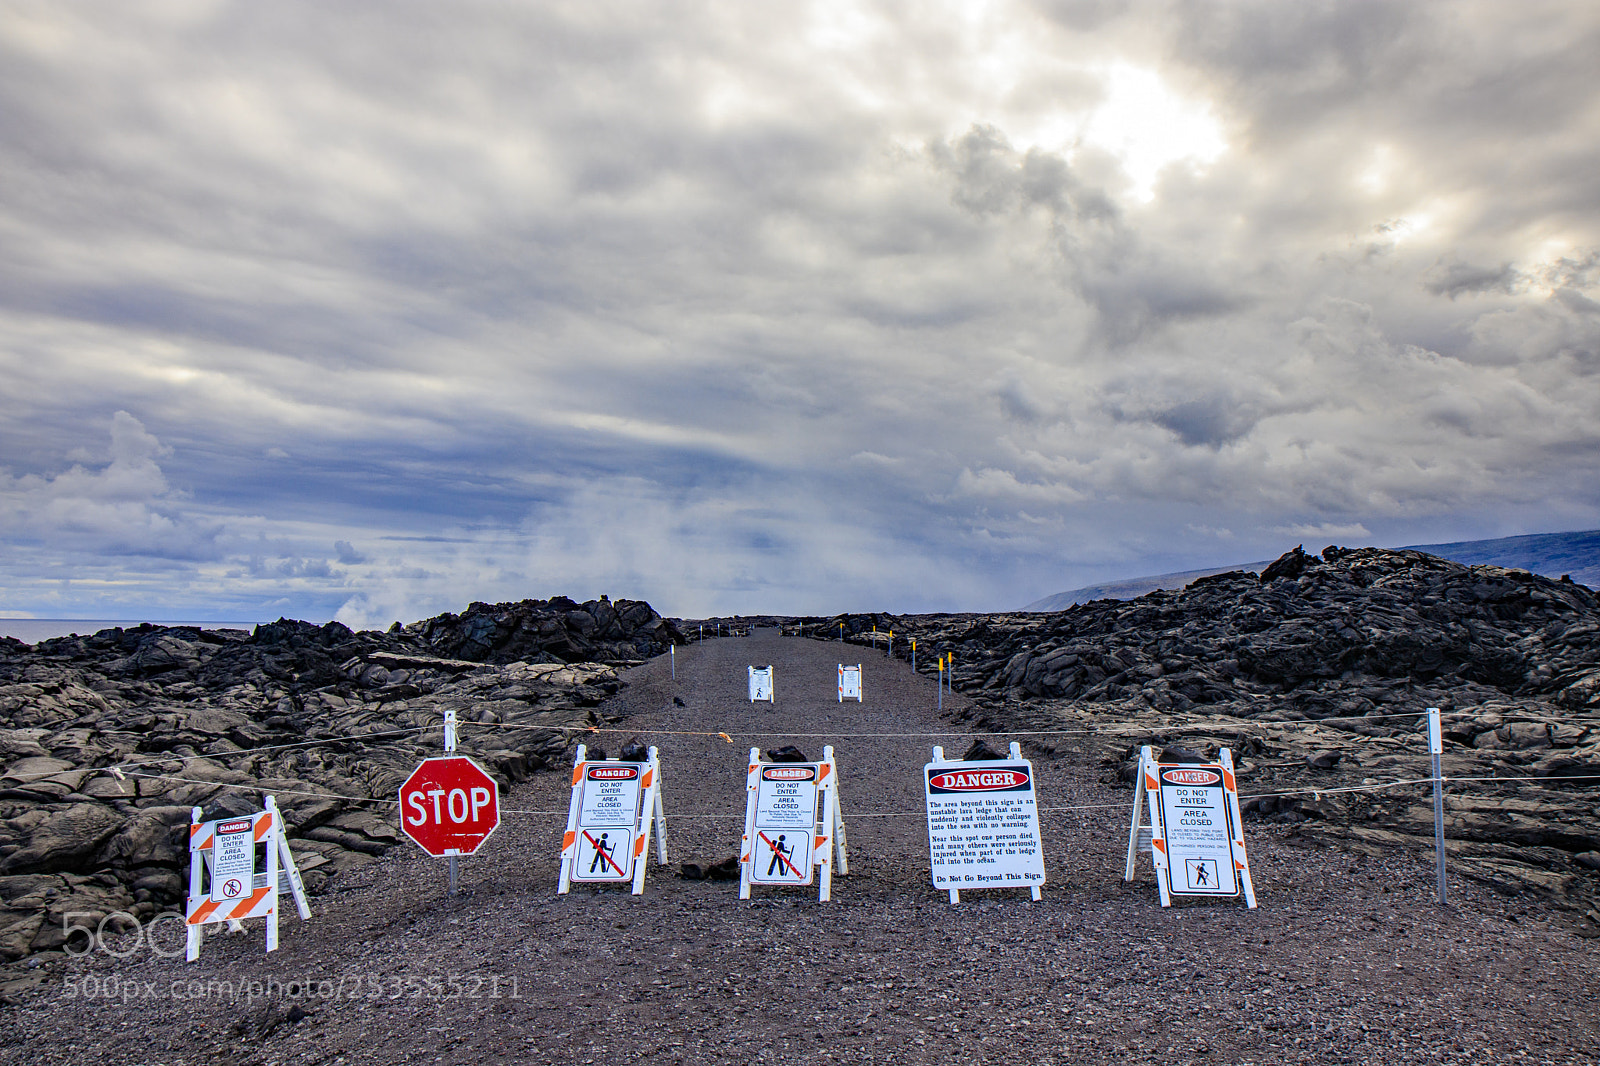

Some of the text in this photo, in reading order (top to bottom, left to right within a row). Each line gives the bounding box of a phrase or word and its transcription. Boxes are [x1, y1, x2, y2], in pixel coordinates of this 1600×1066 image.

[942, 773, 1016, 788] DANGER
[1172, 772, 1209, 781] DANGER
[407, 787, 491, 826] STOP
[220, 823, 249, 832] DANGER
[977, 874, 1002, 882] Beyond
